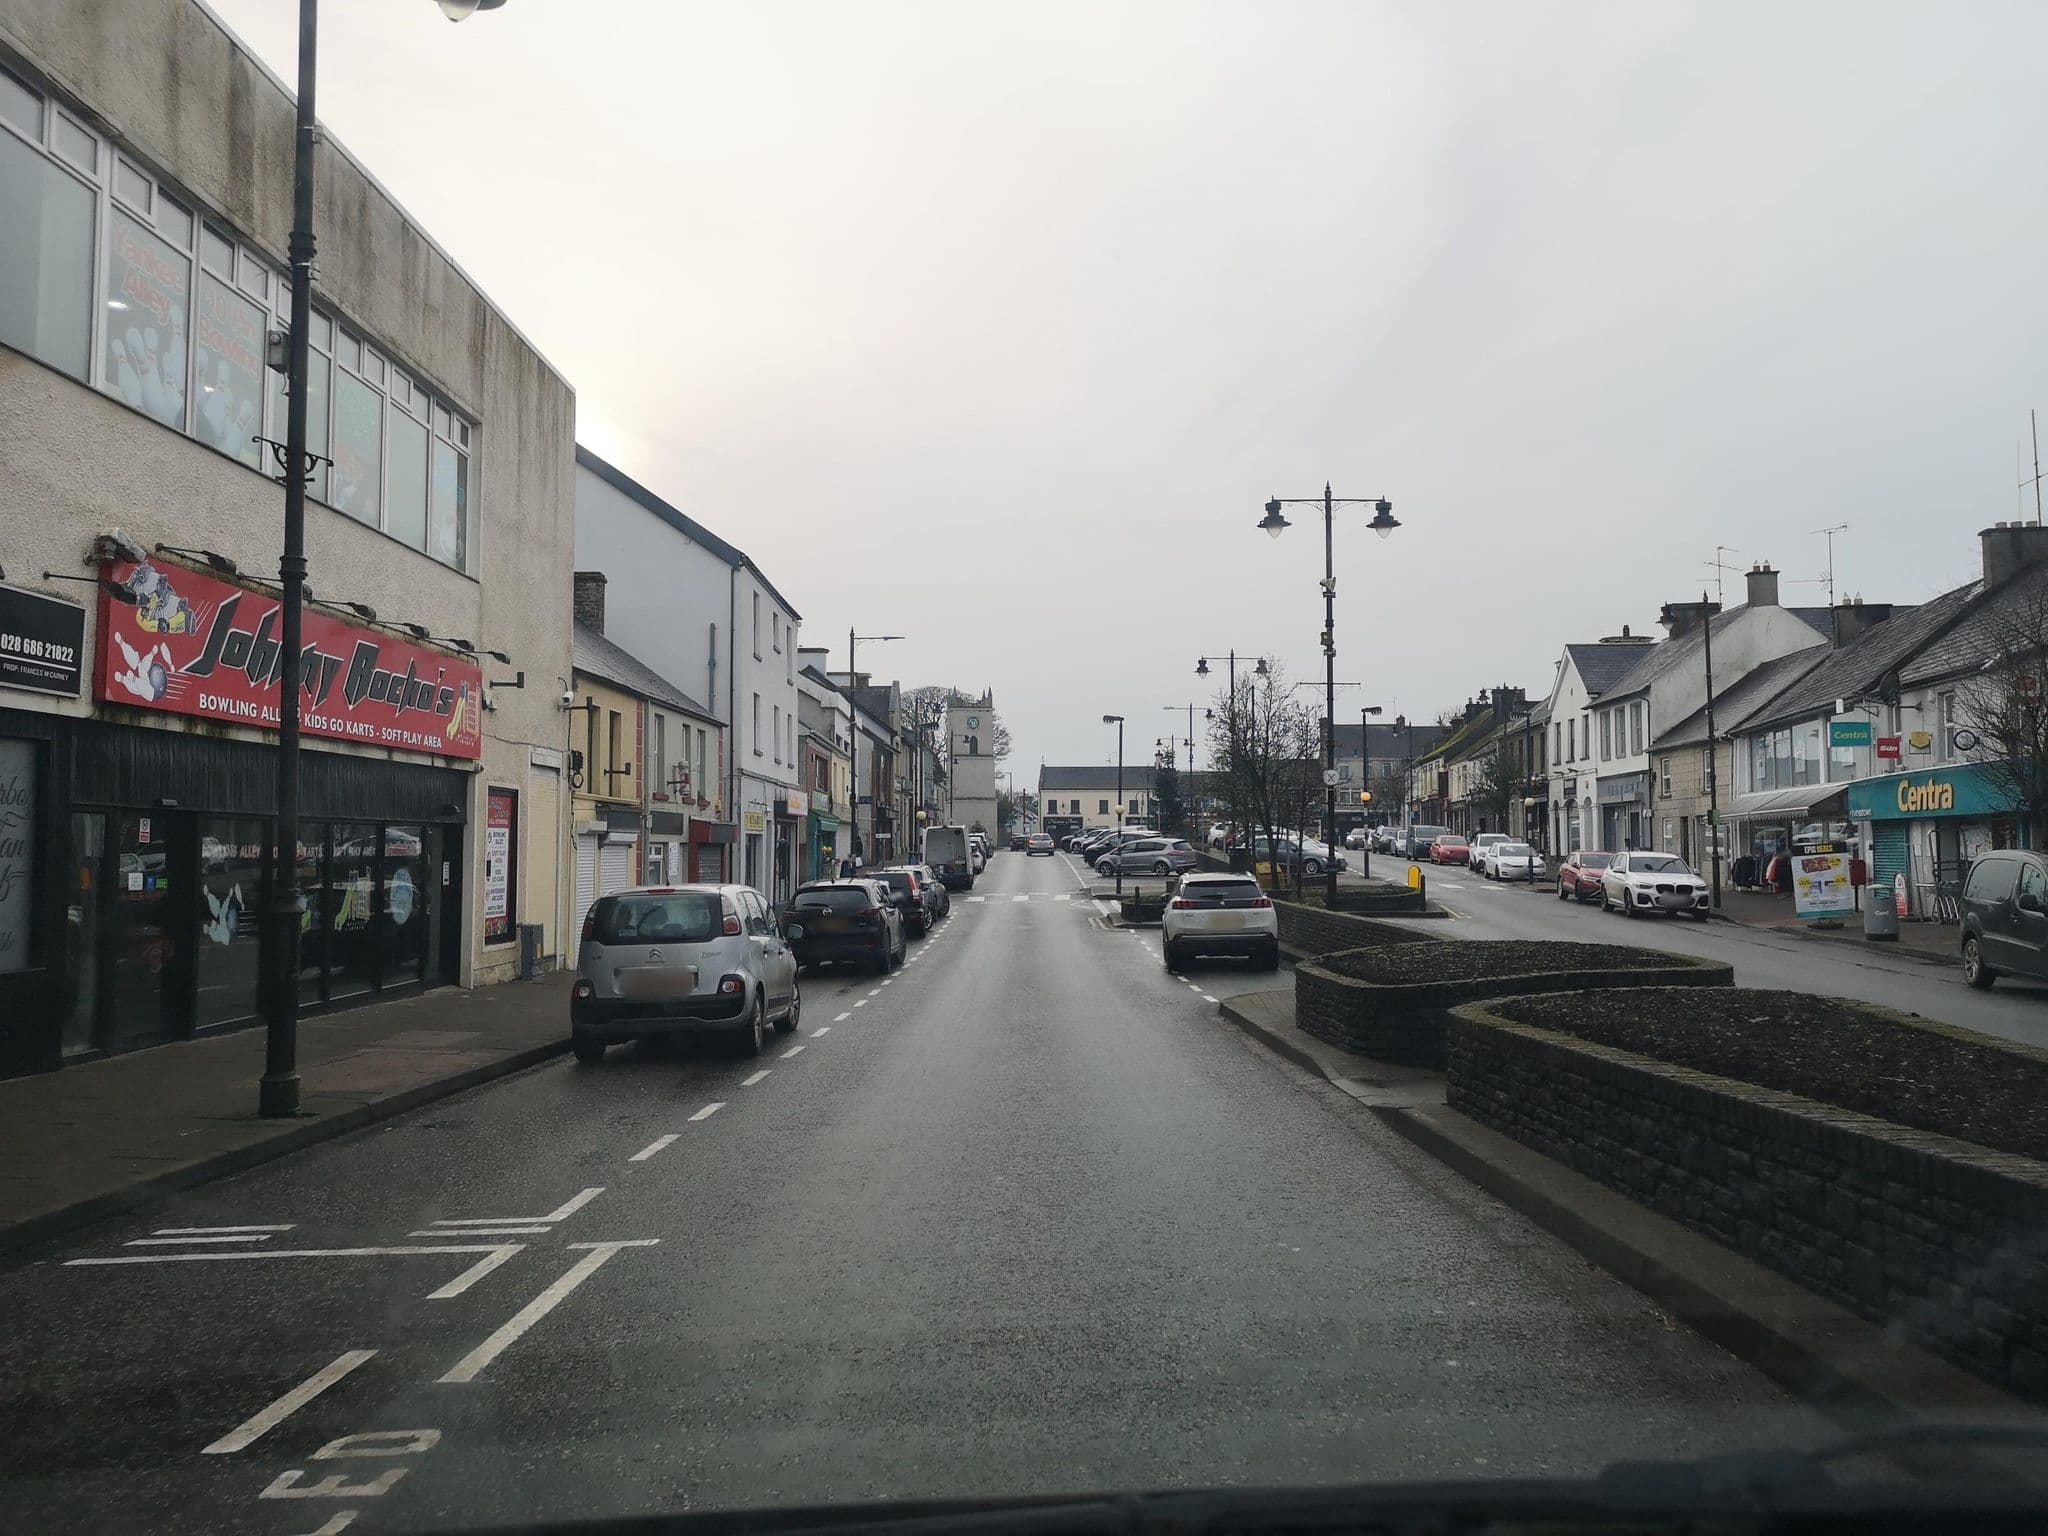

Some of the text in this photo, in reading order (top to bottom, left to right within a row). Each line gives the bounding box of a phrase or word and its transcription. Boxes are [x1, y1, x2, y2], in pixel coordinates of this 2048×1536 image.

[1, 633, 74, 663] 028 686 21822
[20, 665, 44, 676] FRANCES
[198, 693, 258, 718] BOWLING
[304, 712, 328, 731] KIDS
[330, 719, 344, 733] GO
[345, 720, 375, 737] KARTS
[381, 726, 402, 742] SOFT
[403, 731, 422, 745] PLAY
[423, 734, 442, 749] AREA
[1834, 731, 1867, 739] Centra
[1897, 778, 1953, 812] Centra
